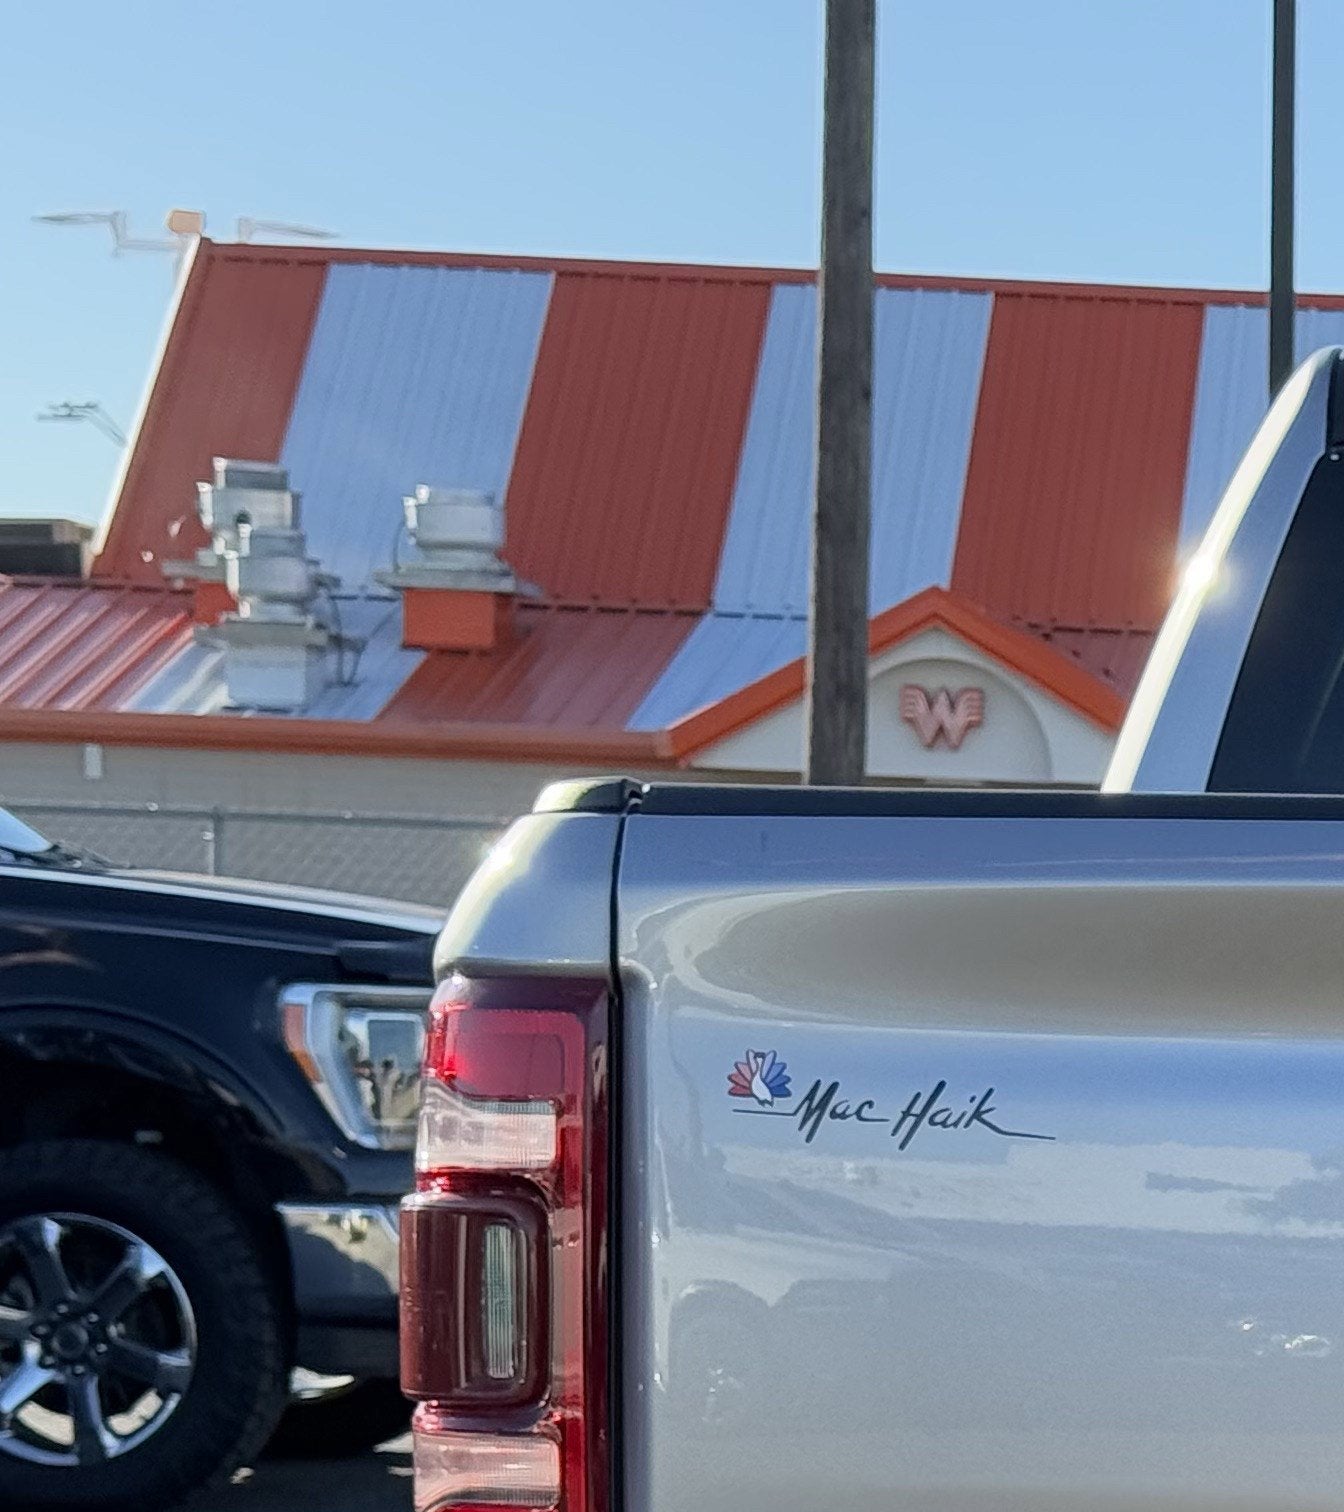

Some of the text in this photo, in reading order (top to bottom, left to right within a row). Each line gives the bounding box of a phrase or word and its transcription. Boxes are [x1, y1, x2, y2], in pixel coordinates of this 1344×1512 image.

[901, 683, 985, 750] W
[733, 1078, 1056, 1151] Mac Haik
